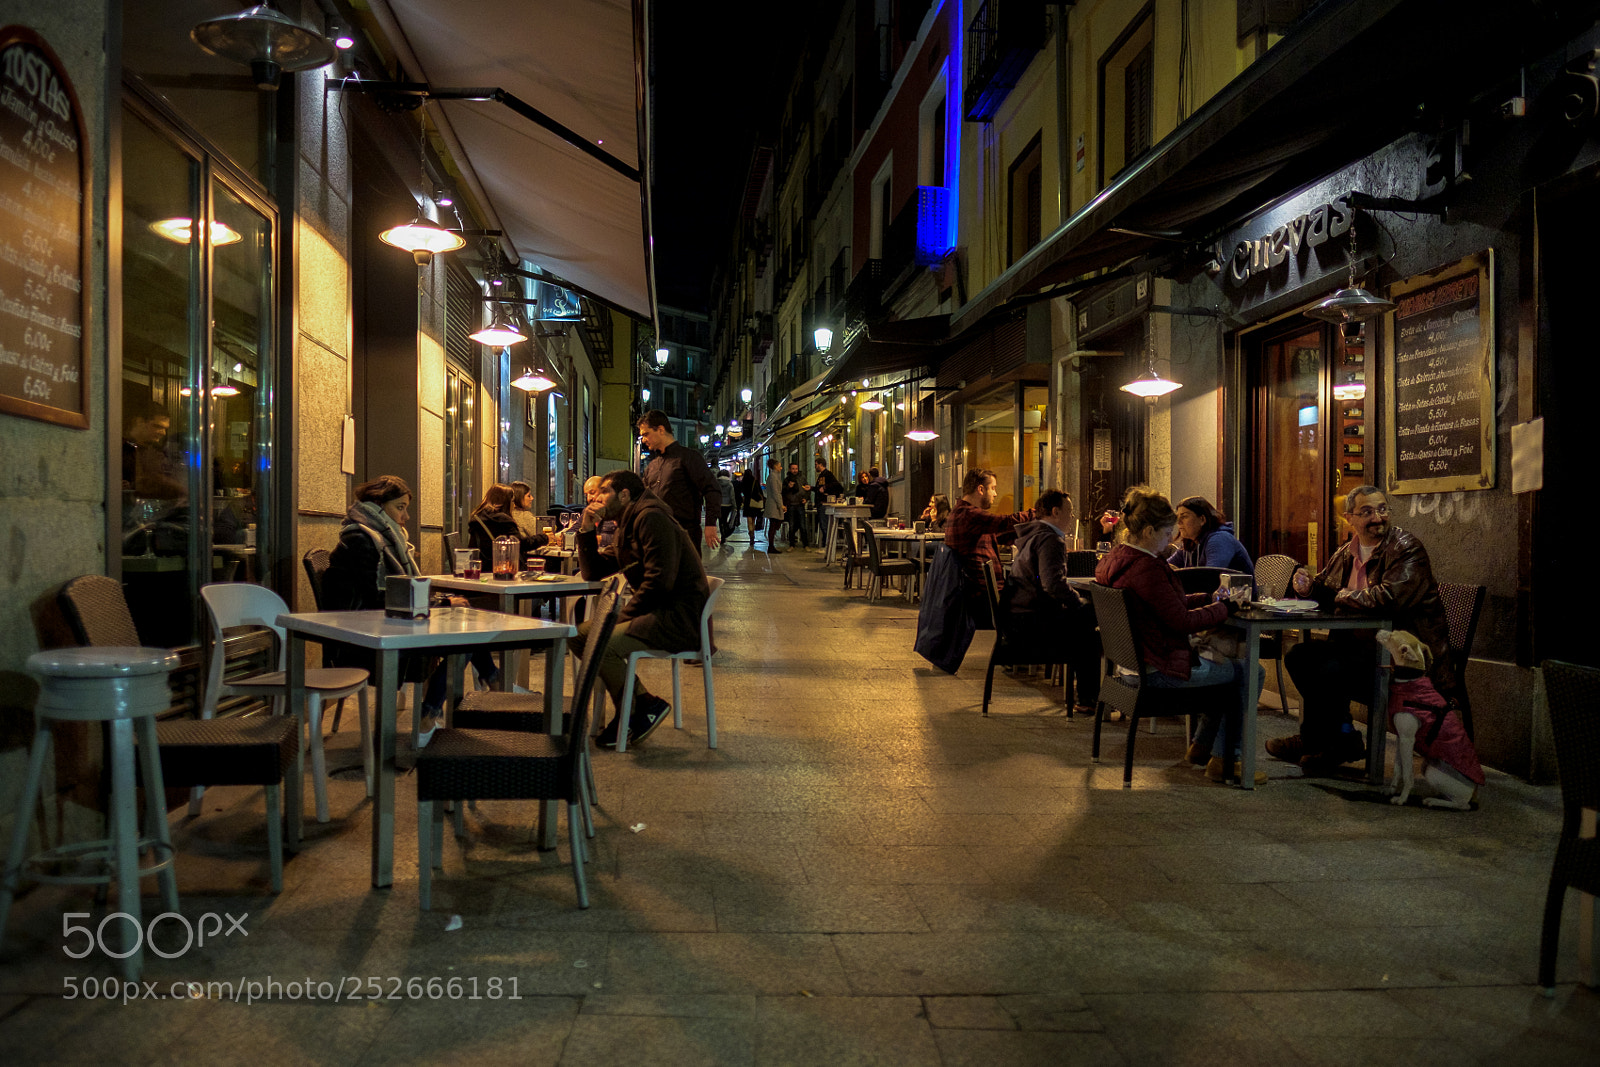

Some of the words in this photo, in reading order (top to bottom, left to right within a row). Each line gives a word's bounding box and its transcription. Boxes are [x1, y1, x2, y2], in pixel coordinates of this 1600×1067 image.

[3, 46, 71, 122] TOSTAS
[45, 120, 77, 152] Queso
[1230, 190, 1352, 288] Cuevas
[1428, 407, 1448, 420] 5,50€
[1428, 460, 1449, 472] 6,50€
